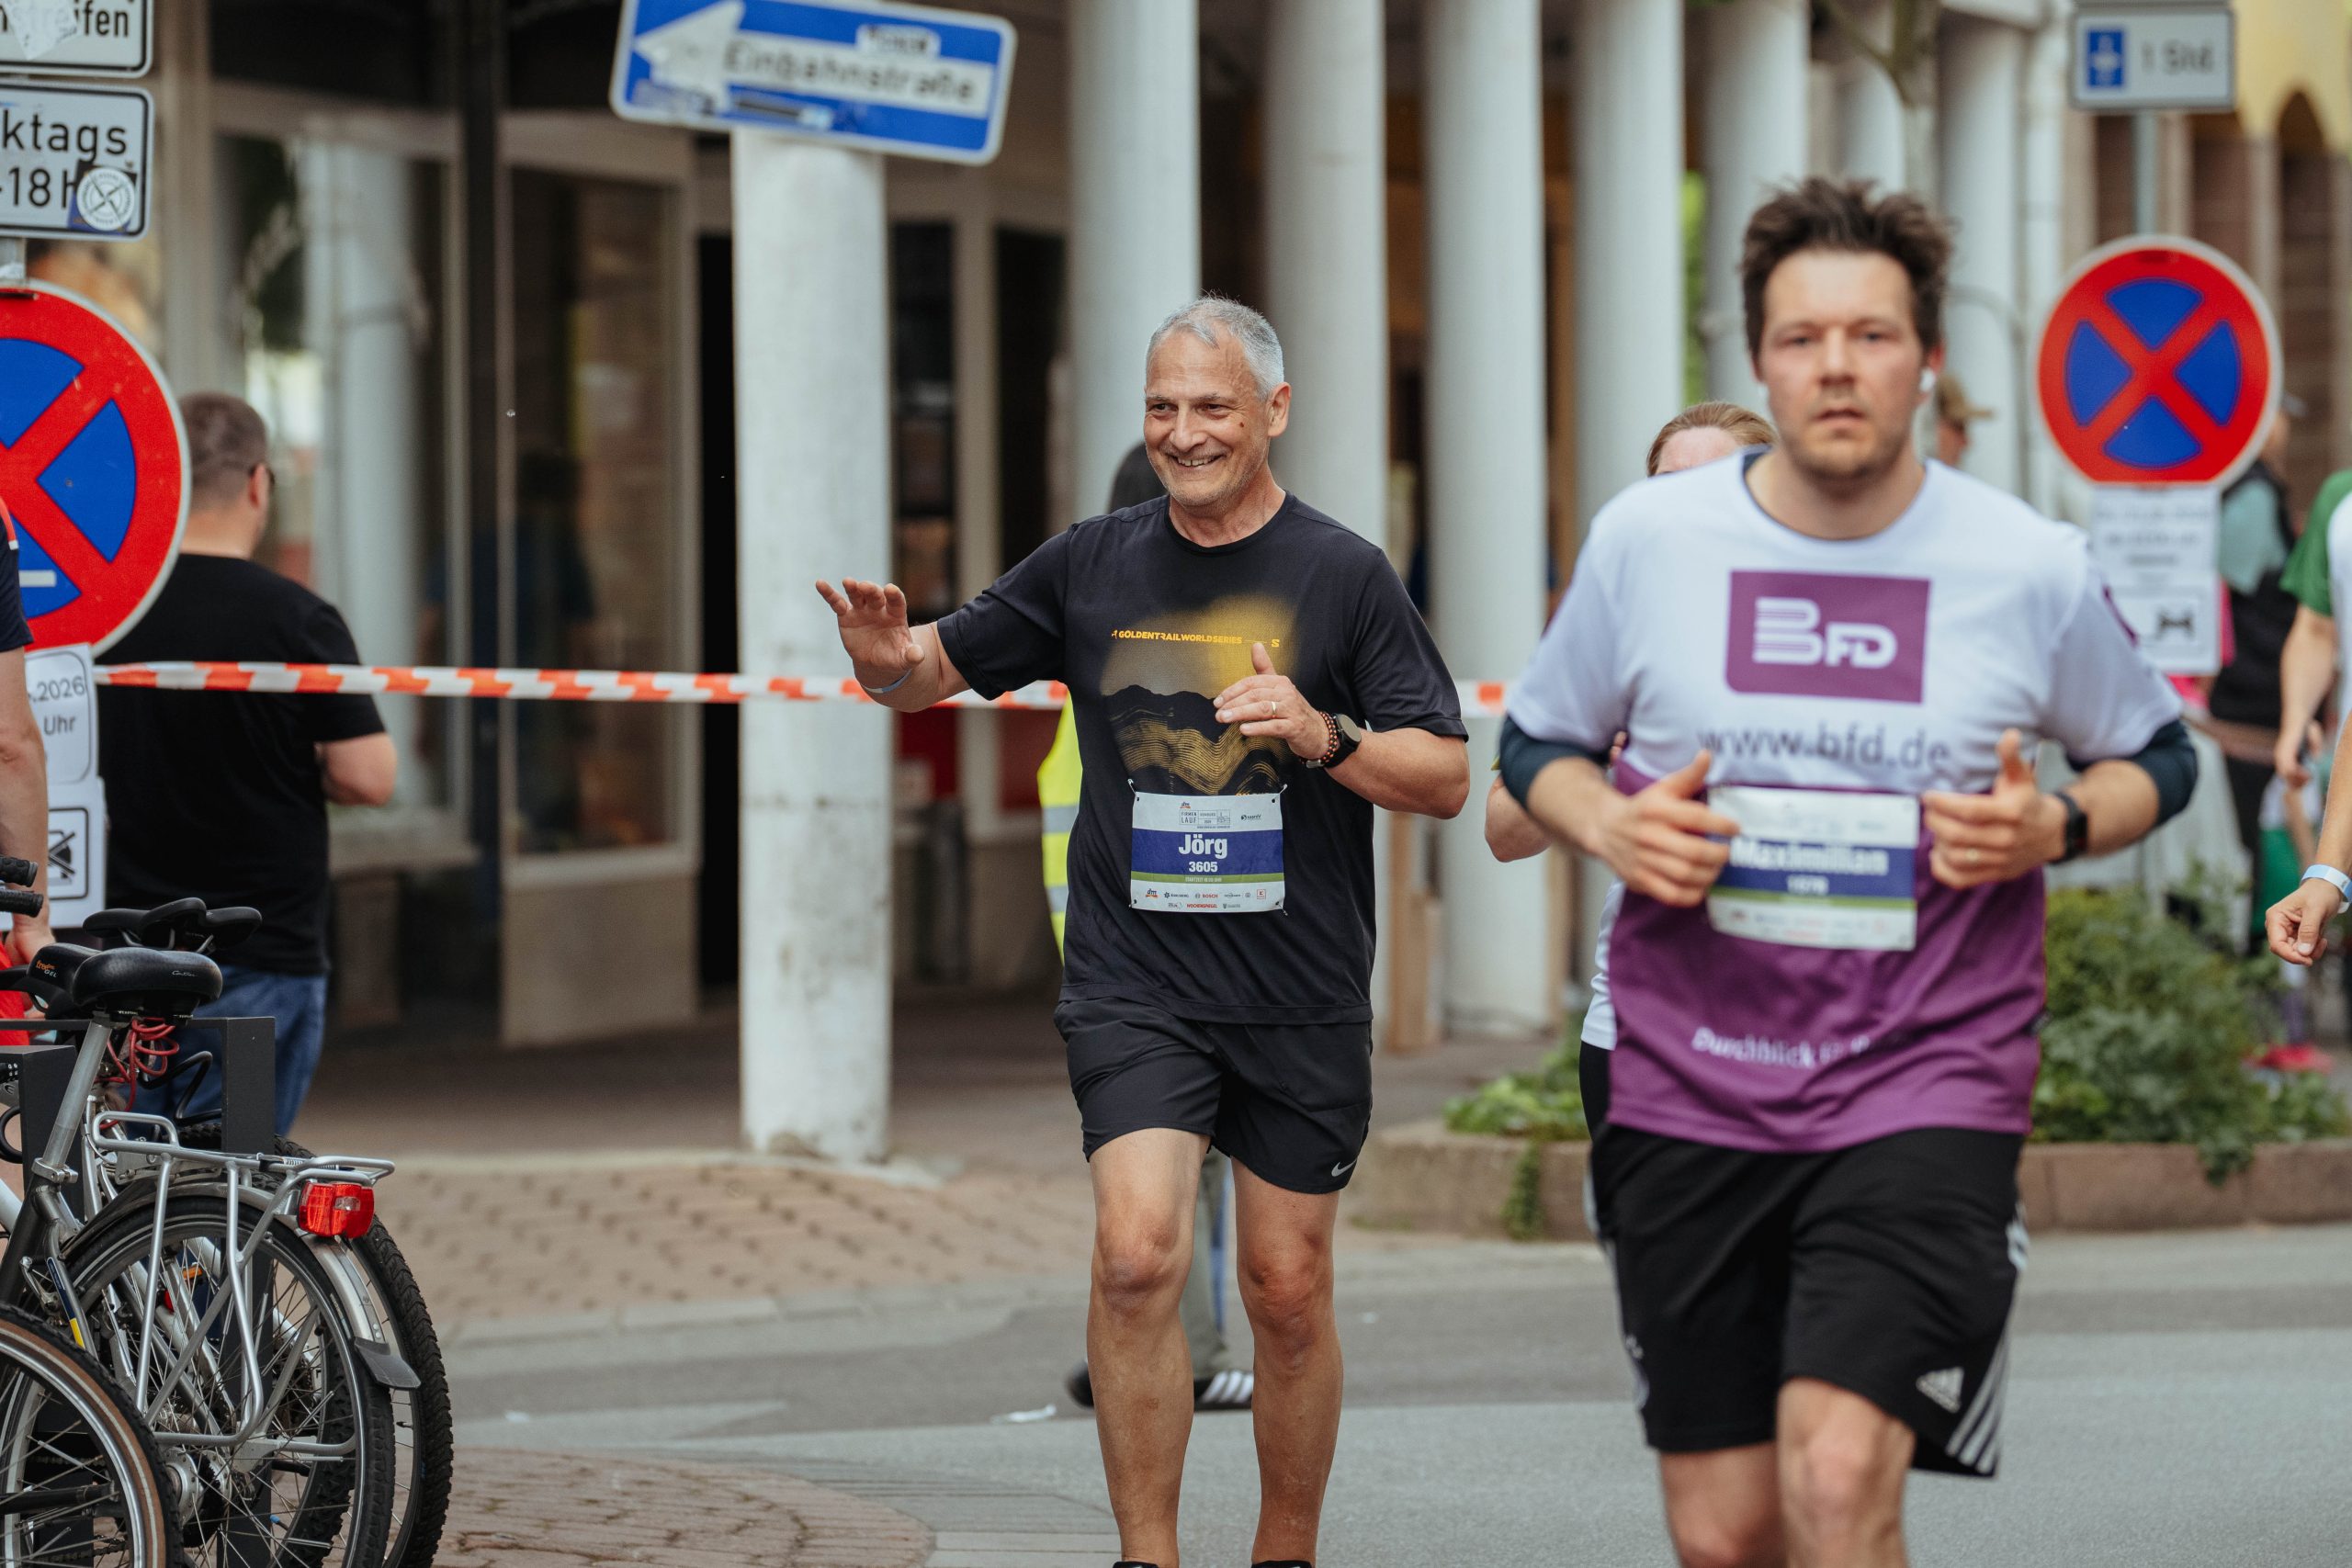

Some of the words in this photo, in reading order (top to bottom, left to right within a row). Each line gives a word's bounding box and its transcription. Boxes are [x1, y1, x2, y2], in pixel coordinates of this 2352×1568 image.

[3, 109, 127, 162] ktags
[1752, 596, 1897, 668] BFD
[28, 675, 85, 703] .2026
[43, 715, 76, 736] Uhr
[1697, 721, 1951, 770] www.bfd.de
[1178, 834, 1228, 859] Jörg
[1188, 861, 1218, 873] 3605
